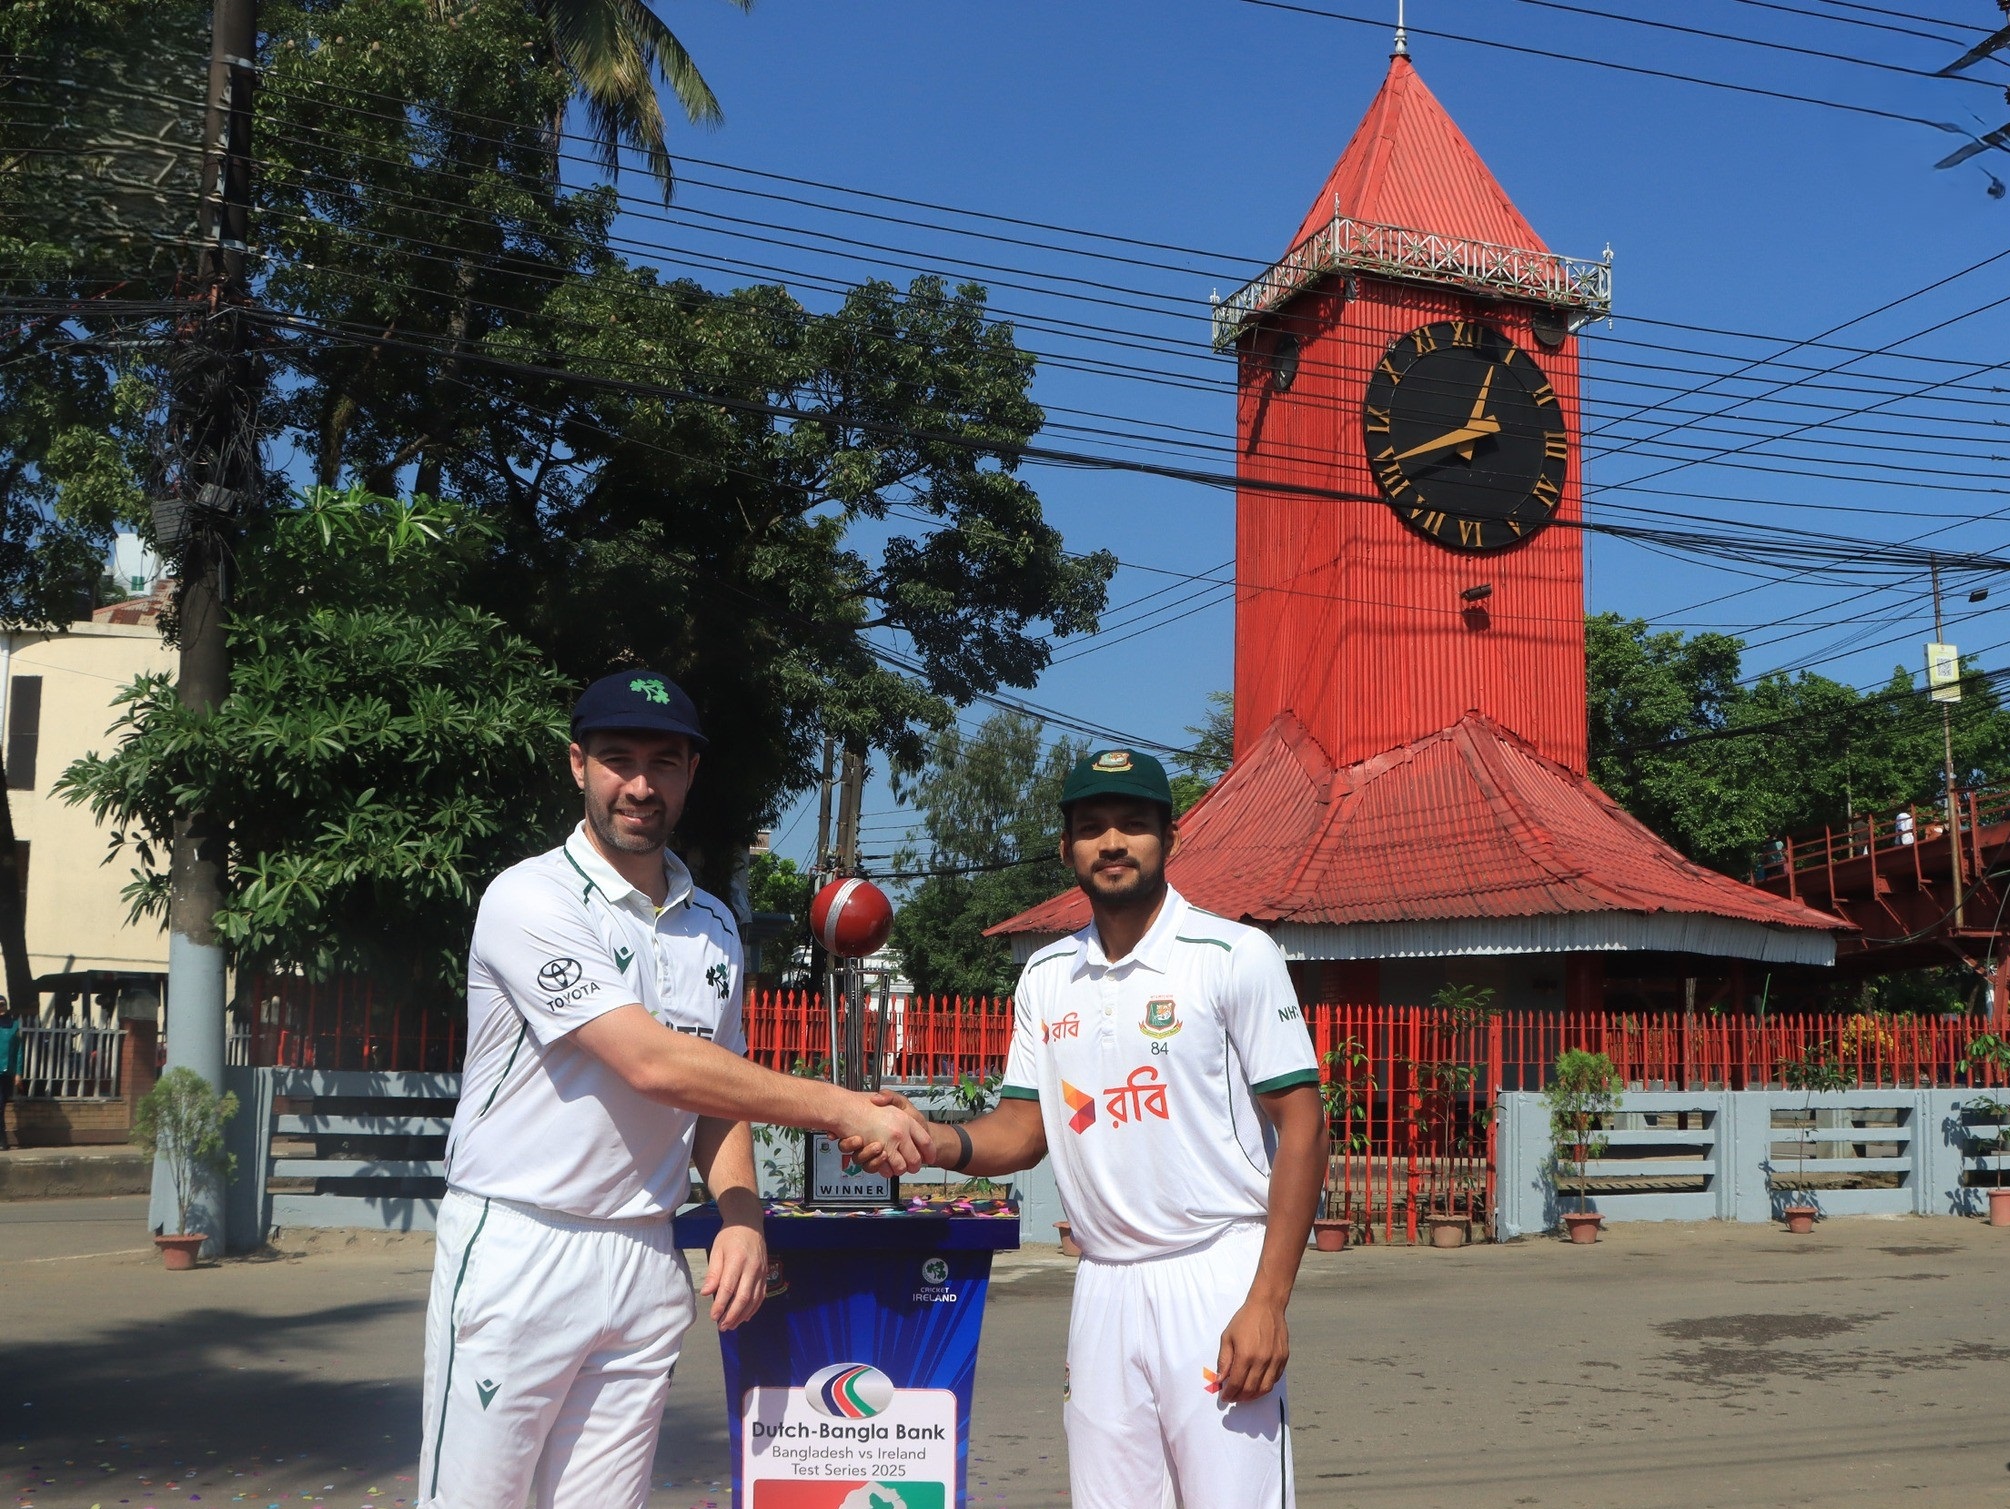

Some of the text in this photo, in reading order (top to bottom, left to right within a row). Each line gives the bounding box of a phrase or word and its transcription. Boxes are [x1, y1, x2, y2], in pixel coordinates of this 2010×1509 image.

[1410, 325, 1438, 358] XI
[1450, 321, 1484, 349] XII
[1378, 357, 1406, 386] X
[1532, 382, 1557, 407] II
[1366, 406, 1391, 434] IX
[1544, 431, 1568, 461] III
[1531, 473, 1560, 512] IV
[1459, 519, 1484, 547] VI
[546, 982, 600, 1013] TOYOTA
[1052, 1012, 1080, 1042] রবি
[1151, 1042, 1169, 1056] 84
[1103, 1066, 1169, 1129] রবি
[820, 1185, 884, 1195] WINNER
[912, 1293, 957, 1302] IRELAND
[752, 1421, 945, 1443] Dutch-Bangla Bank
[772, 1445, 926, 1461] Bangladesh vs Ireland
[791, 1462, 906, 1477] Test Series 2025
